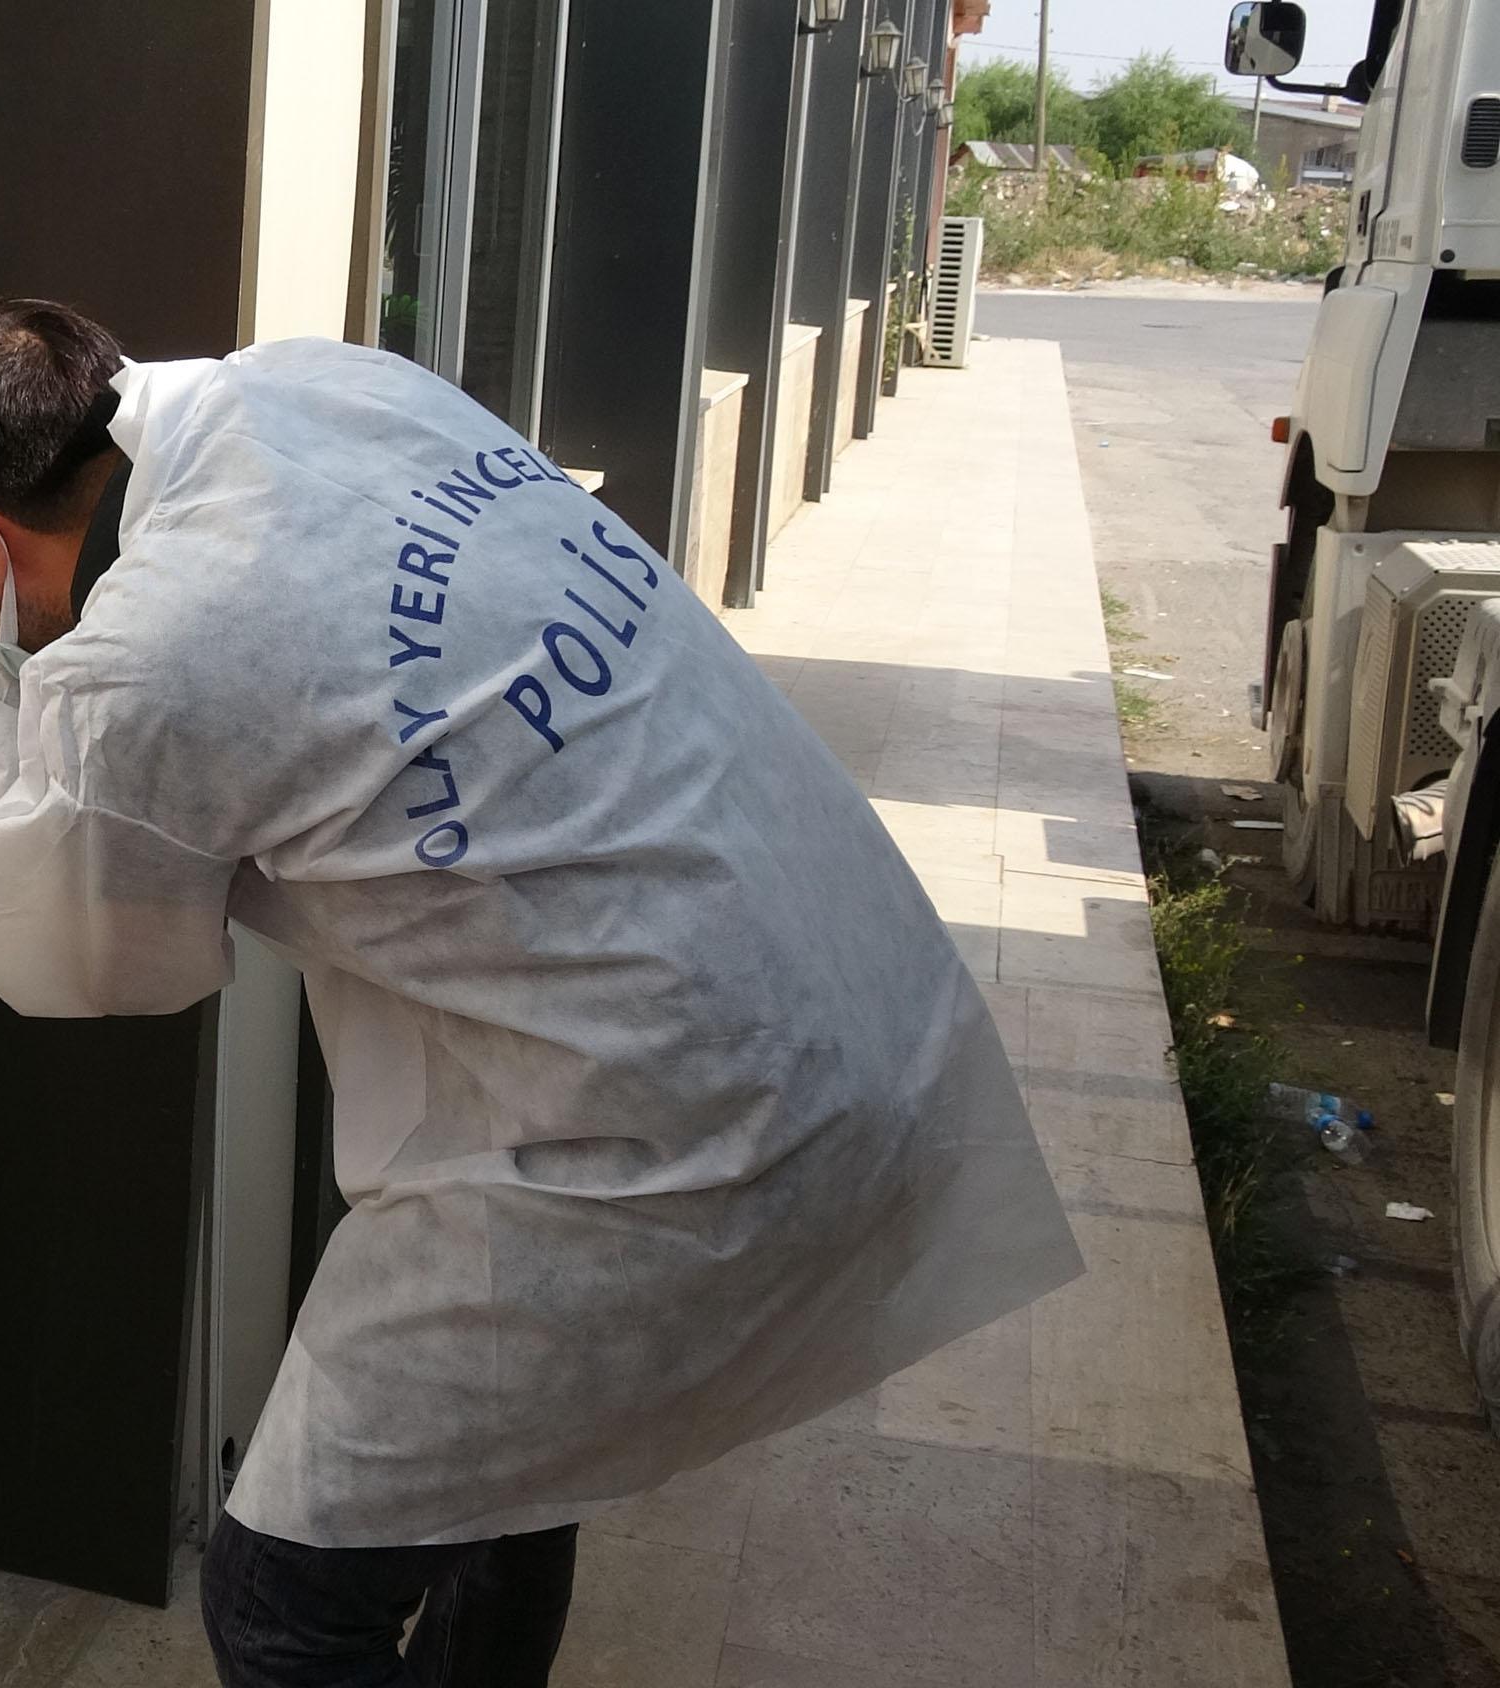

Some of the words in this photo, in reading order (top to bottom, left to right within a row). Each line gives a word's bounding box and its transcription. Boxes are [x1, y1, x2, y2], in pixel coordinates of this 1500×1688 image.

[411, 447, 584, 526] İNCEL
[390, 516, 460, 668] YERİ
[503, 520, 659, 753] POLİS
